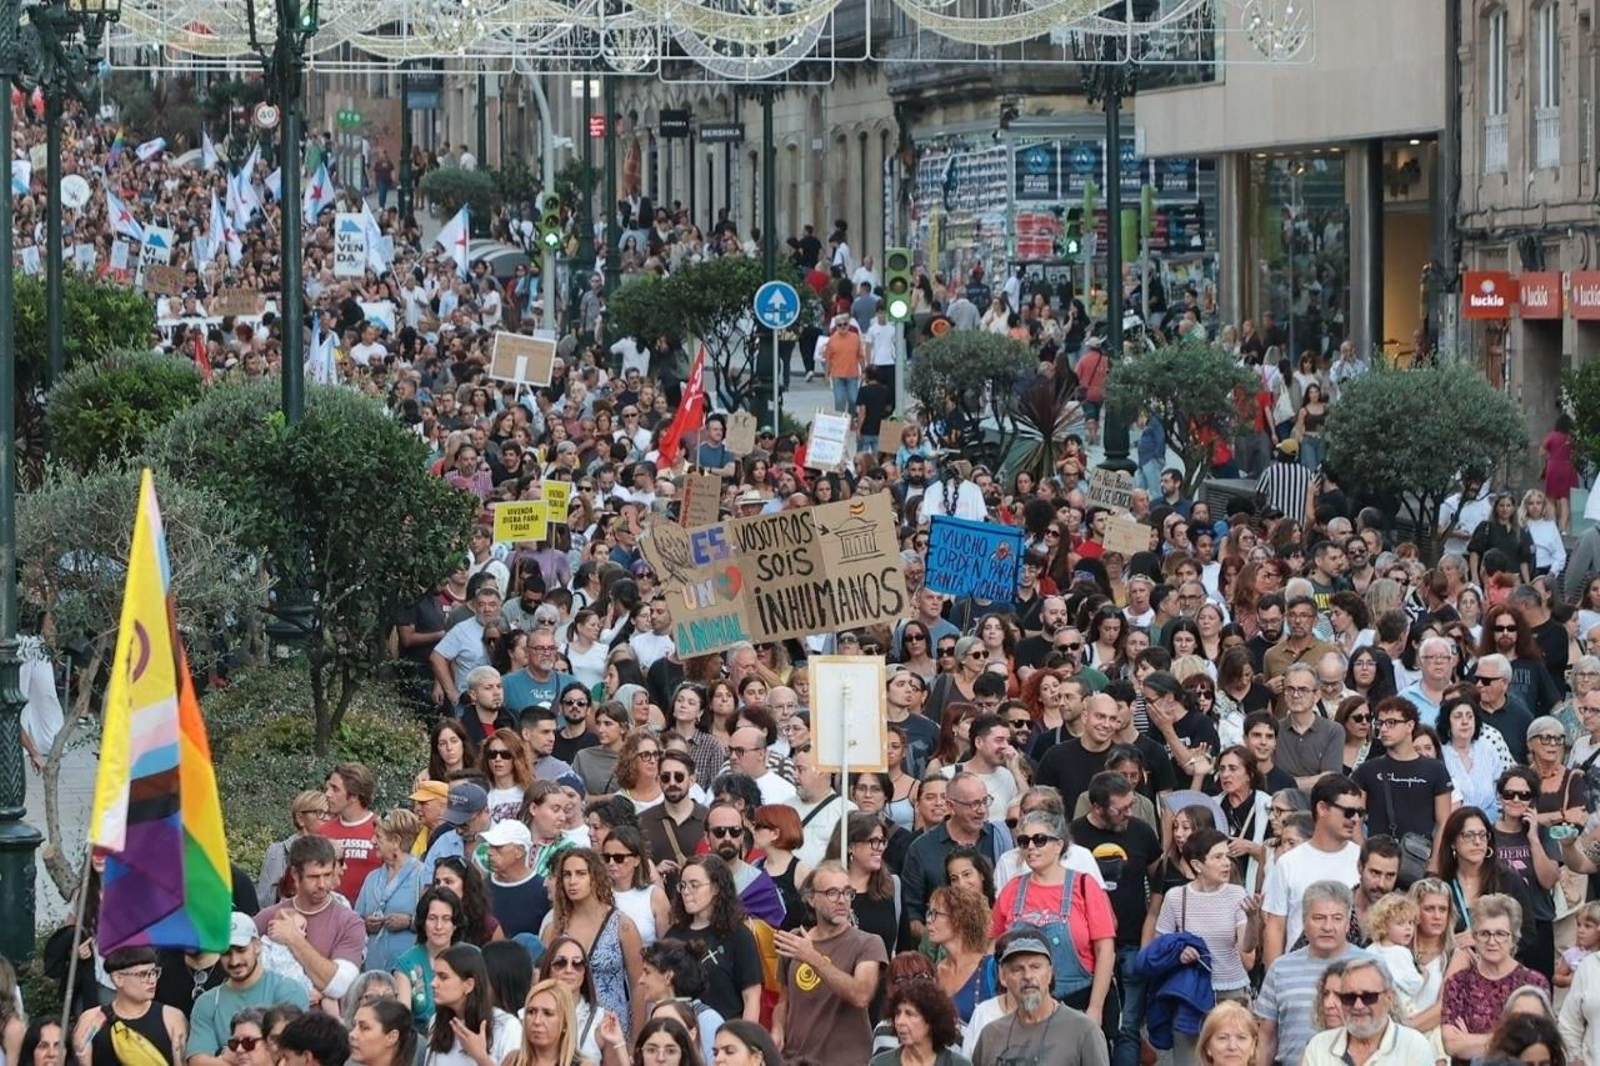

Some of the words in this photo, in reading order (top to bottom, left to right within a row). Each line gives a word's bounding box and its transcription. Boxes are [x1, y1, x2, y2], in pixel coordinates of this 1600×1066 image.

[259, 109, 275, 119] 40
[701, 129, 740, 137] BERSHKA
[338, 244, 364, 252] VEN
[337, 254, 356, 262] DA
[1470, 294, 1505, 307] luckia
[523, 514, 539, 522] PARA
[734, 511, 813, 554] VOSOTROS
[691, 526, 730, 567] ES
[939, 528, 988, 558] MUCHO
[937, 546, 984, 579] ORDEN
[676, 612, 751, 655] ANIMAL
